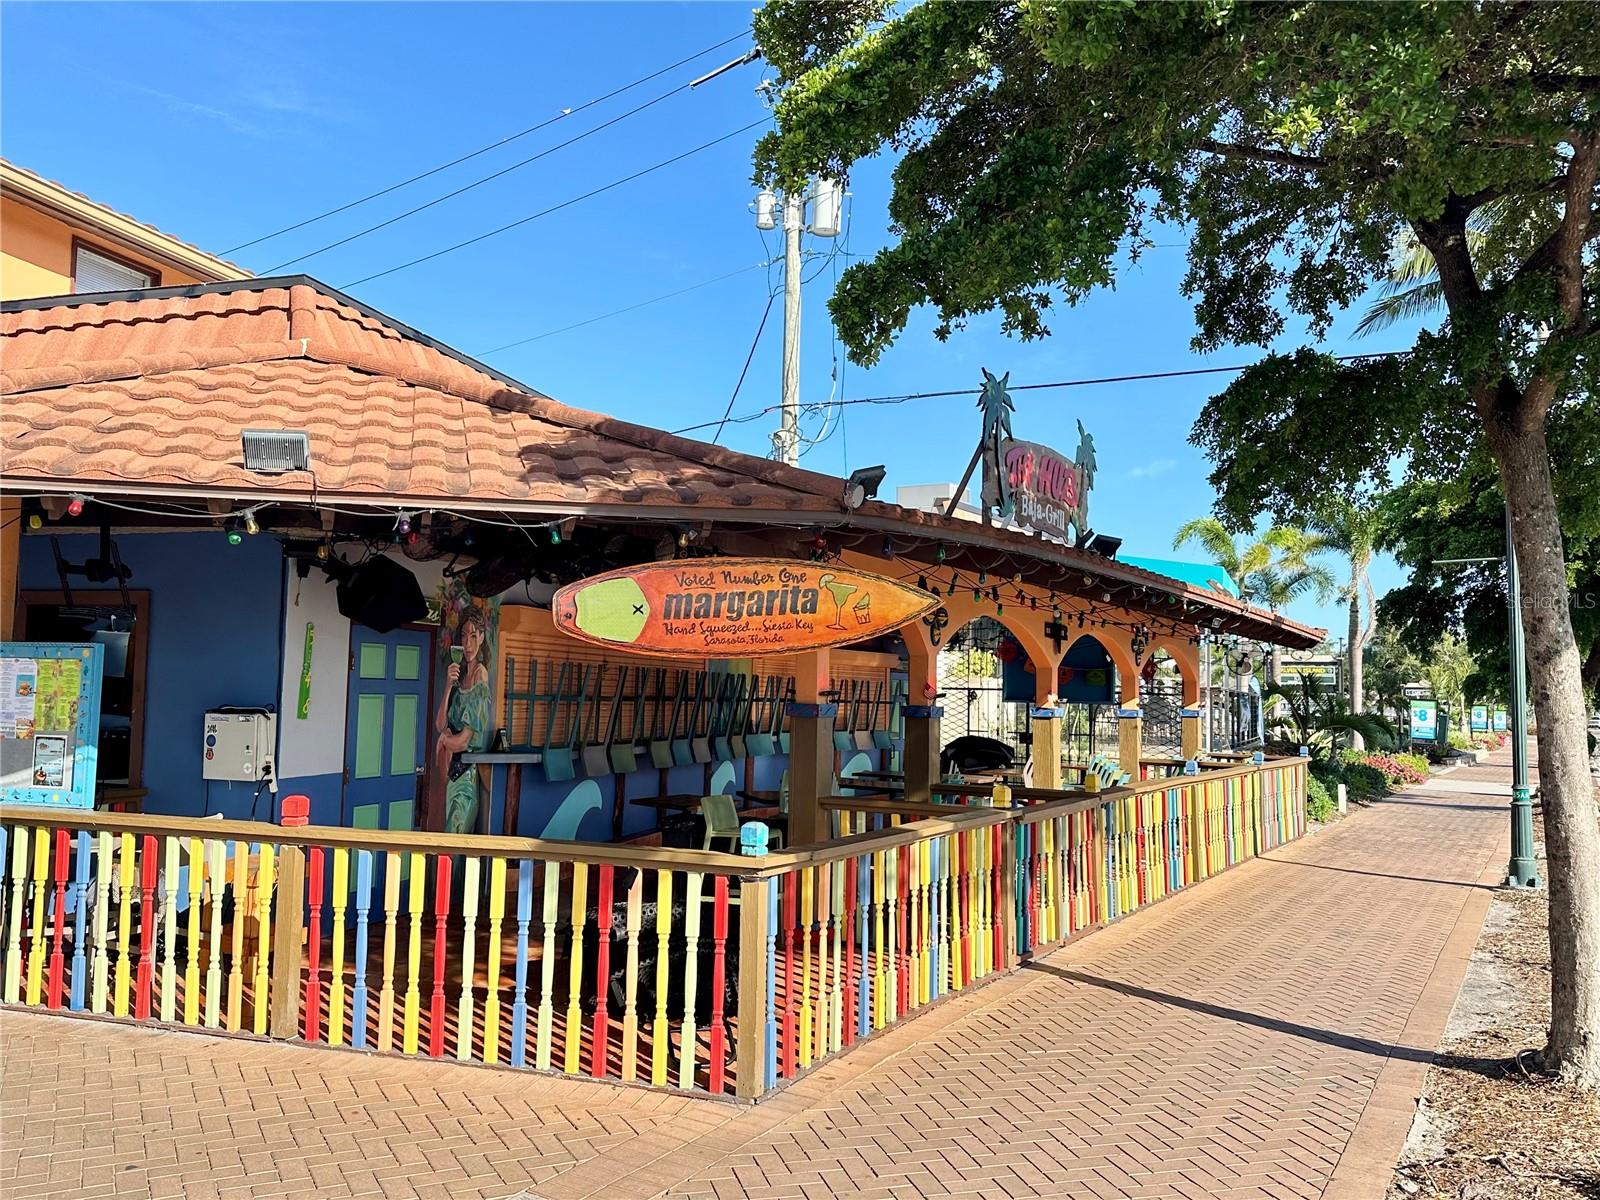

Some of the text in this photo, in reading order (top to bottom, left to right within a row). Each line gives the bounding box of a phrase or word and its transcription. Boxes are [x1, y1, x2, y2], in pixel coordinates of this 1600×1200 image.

[1037, 455, 1079, 507] HUB
[1021, 495, 1065, 531] Baja-Grill
[674, 567, 807, 587] Voted Number One
[663, 584, 819, 621] margarita
[662, 622, 696, 635] Hand
[795, 618, 814, 633] Key
[1413, 709, 1428, 721] $8
